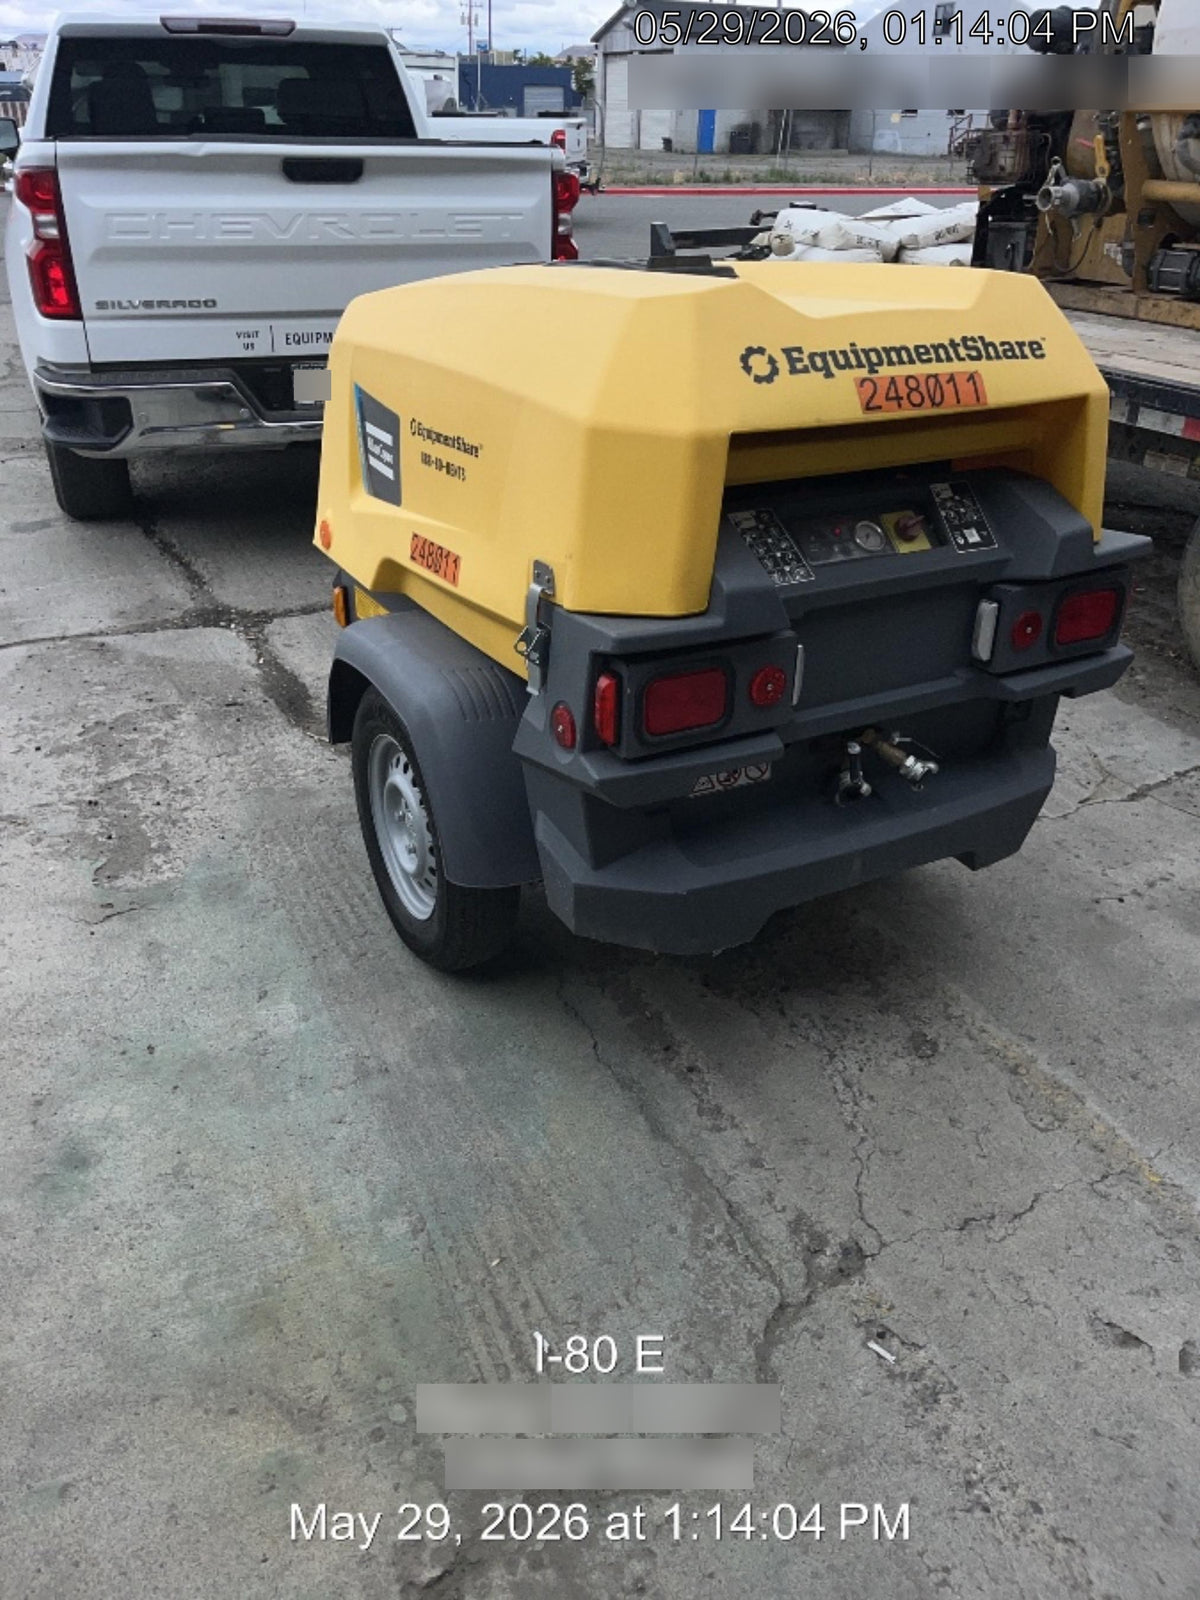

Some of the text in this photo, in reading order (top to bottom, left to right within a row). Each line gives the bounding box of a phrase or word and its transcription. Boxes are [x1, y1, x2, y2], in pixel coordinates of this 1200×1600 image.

[104, 212, 524, 240] CHEVROLET
[95, 299, 218, 310] SILVERADO
[236, 330, 259, 339] VISIT
[243, 342, 255, 351] US
[781, 335, 1046, 378] EquipmentShare
[857, 370, 983, 412] 248011
[410, 533, 459, 584] 248011
